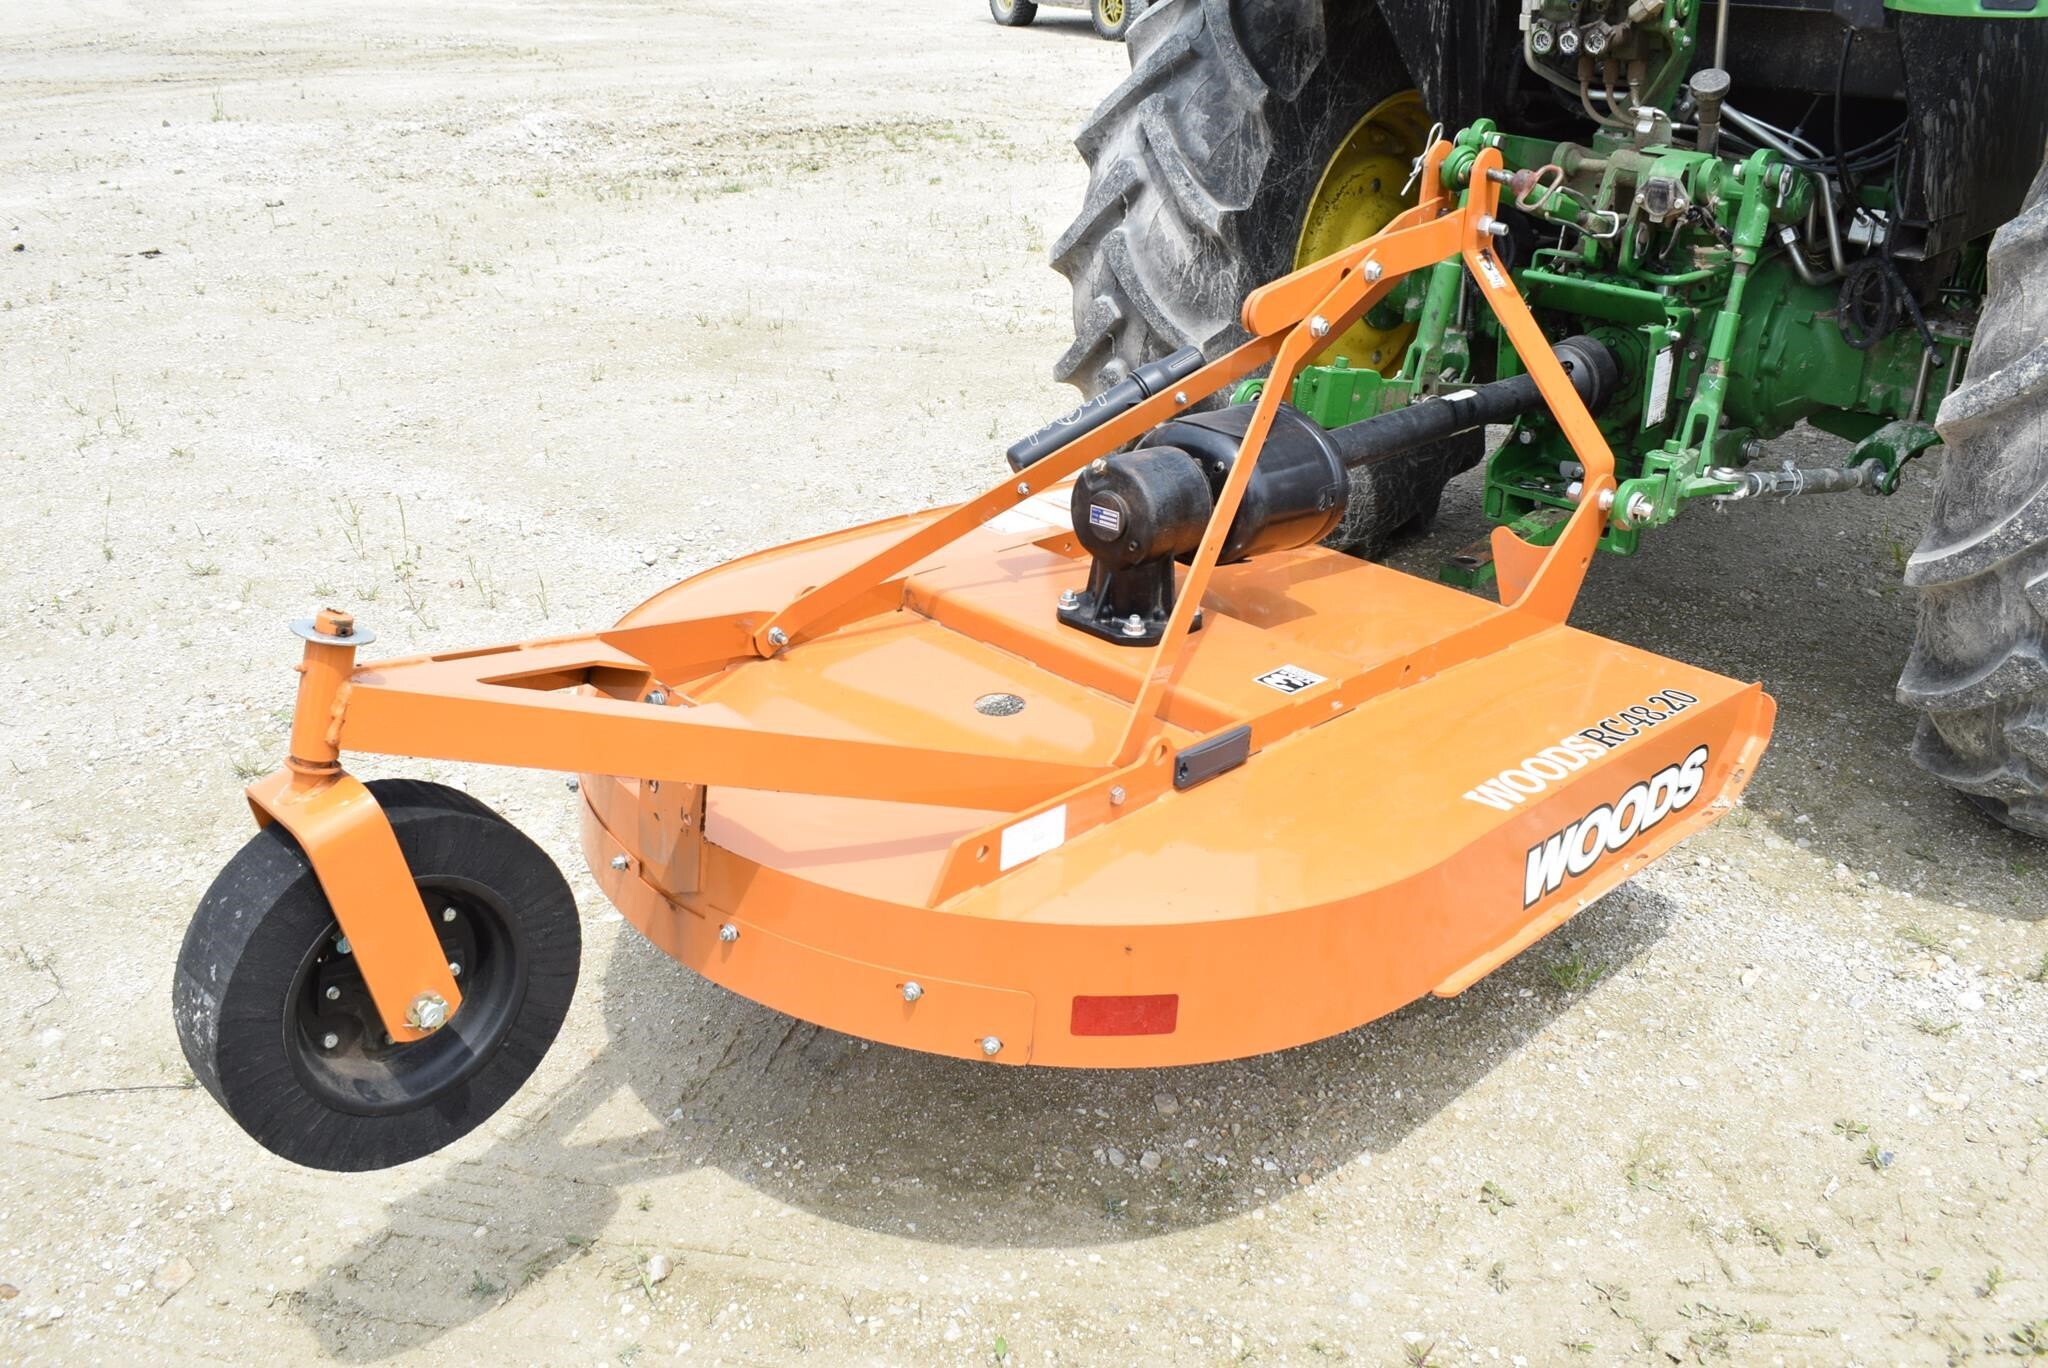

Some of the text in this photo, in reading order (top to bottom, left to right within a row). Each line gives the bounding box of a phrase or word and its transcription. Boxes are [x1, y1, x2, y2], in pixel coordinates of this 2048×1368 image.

[1463, 689, 1698, 811] WOODS RC48.20
[1523, 745, 1709, 909] WOODS
